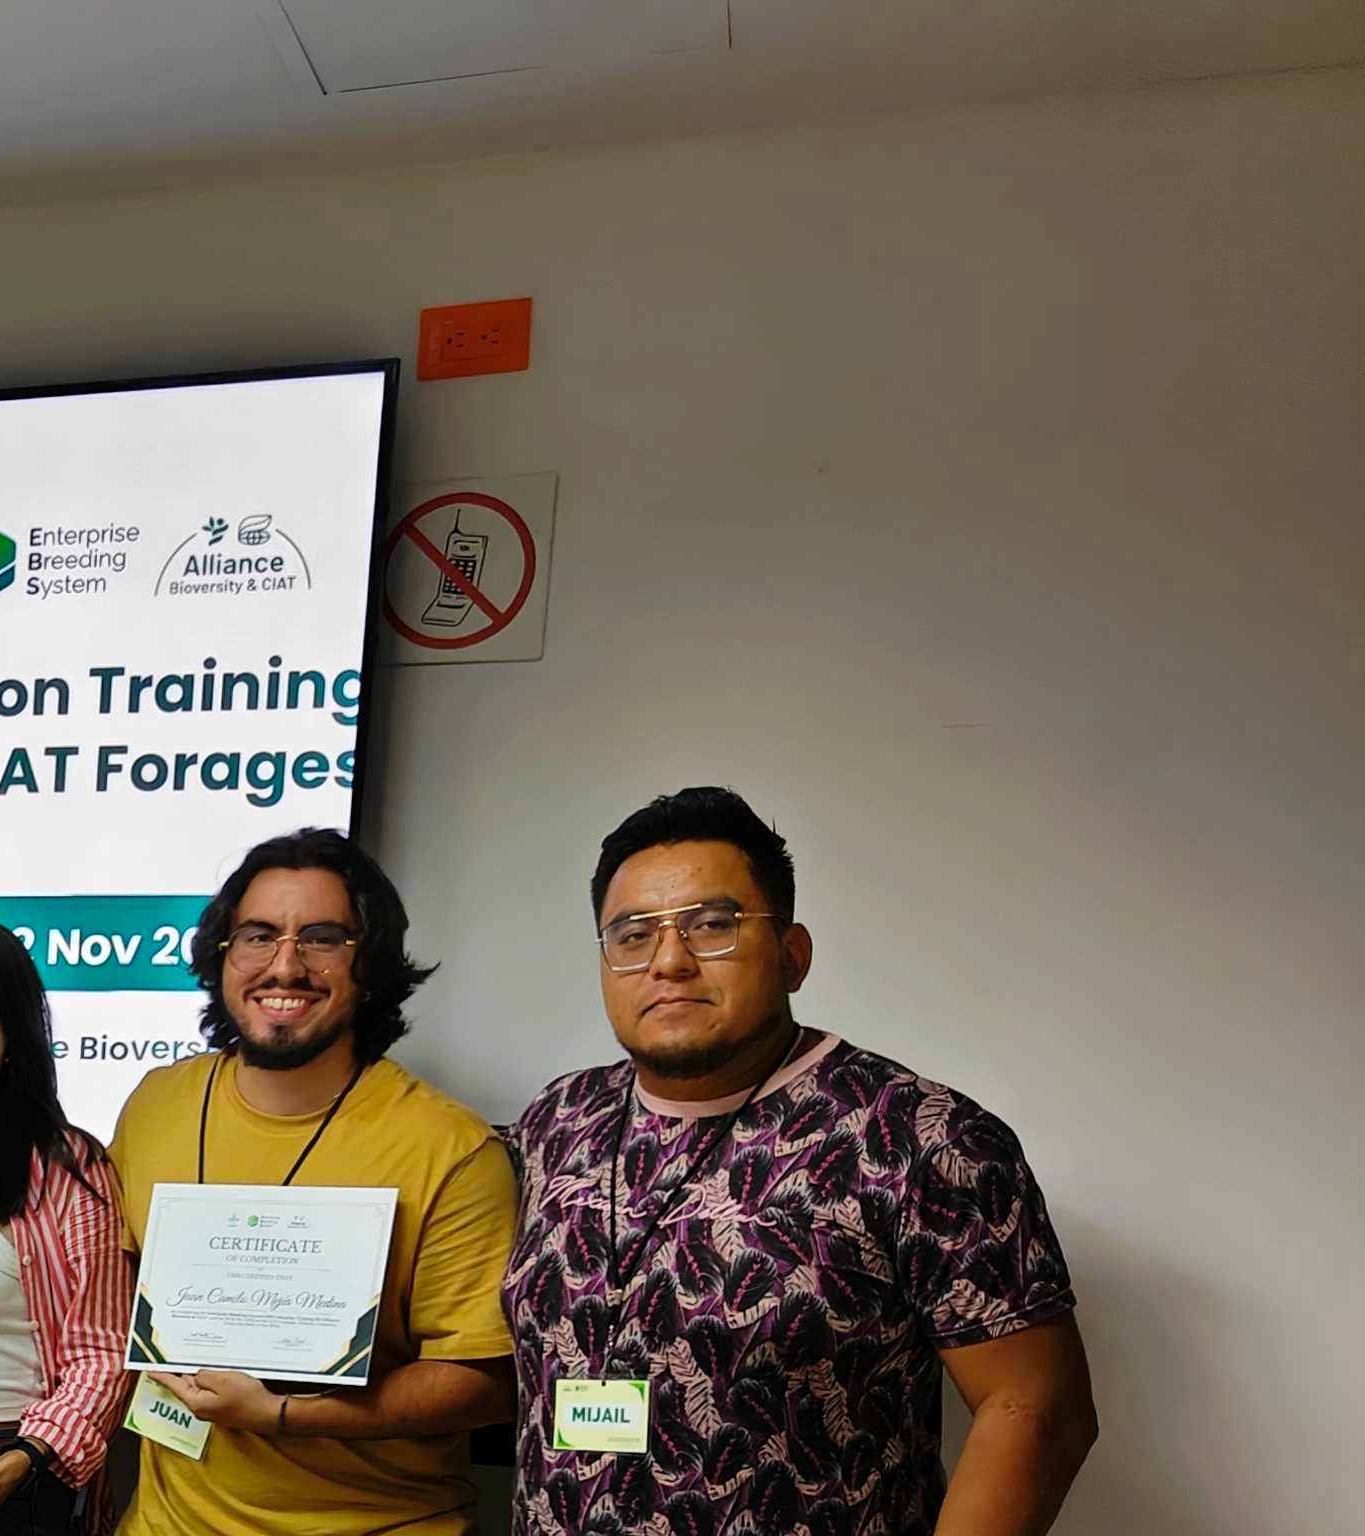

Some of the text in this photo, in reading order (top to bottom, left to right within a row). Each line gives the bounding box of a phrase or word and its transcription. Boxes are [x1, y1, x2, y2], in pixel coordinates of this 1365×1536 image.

[29, 523, 140, 548] Enterprise
[27, 549, 127, 572] Breeding
[182, 553, 285, 578] Alliance
[26, 575, 107, 600] System
[168, 576, 297, 596] Bioversity & CIAT
[89, 655, 362, 725] Training
[95, 745, 356, 808] Forages
[47, 928, 142, 966] Nov
[209, 1236, 322, 1253] CERTIFICATE
[239, 1255, 299, 1264] COMPLETION
[149, 1399, 193, 1429] JUAN
[572, 1407, 630, 1423] MIJAIL
